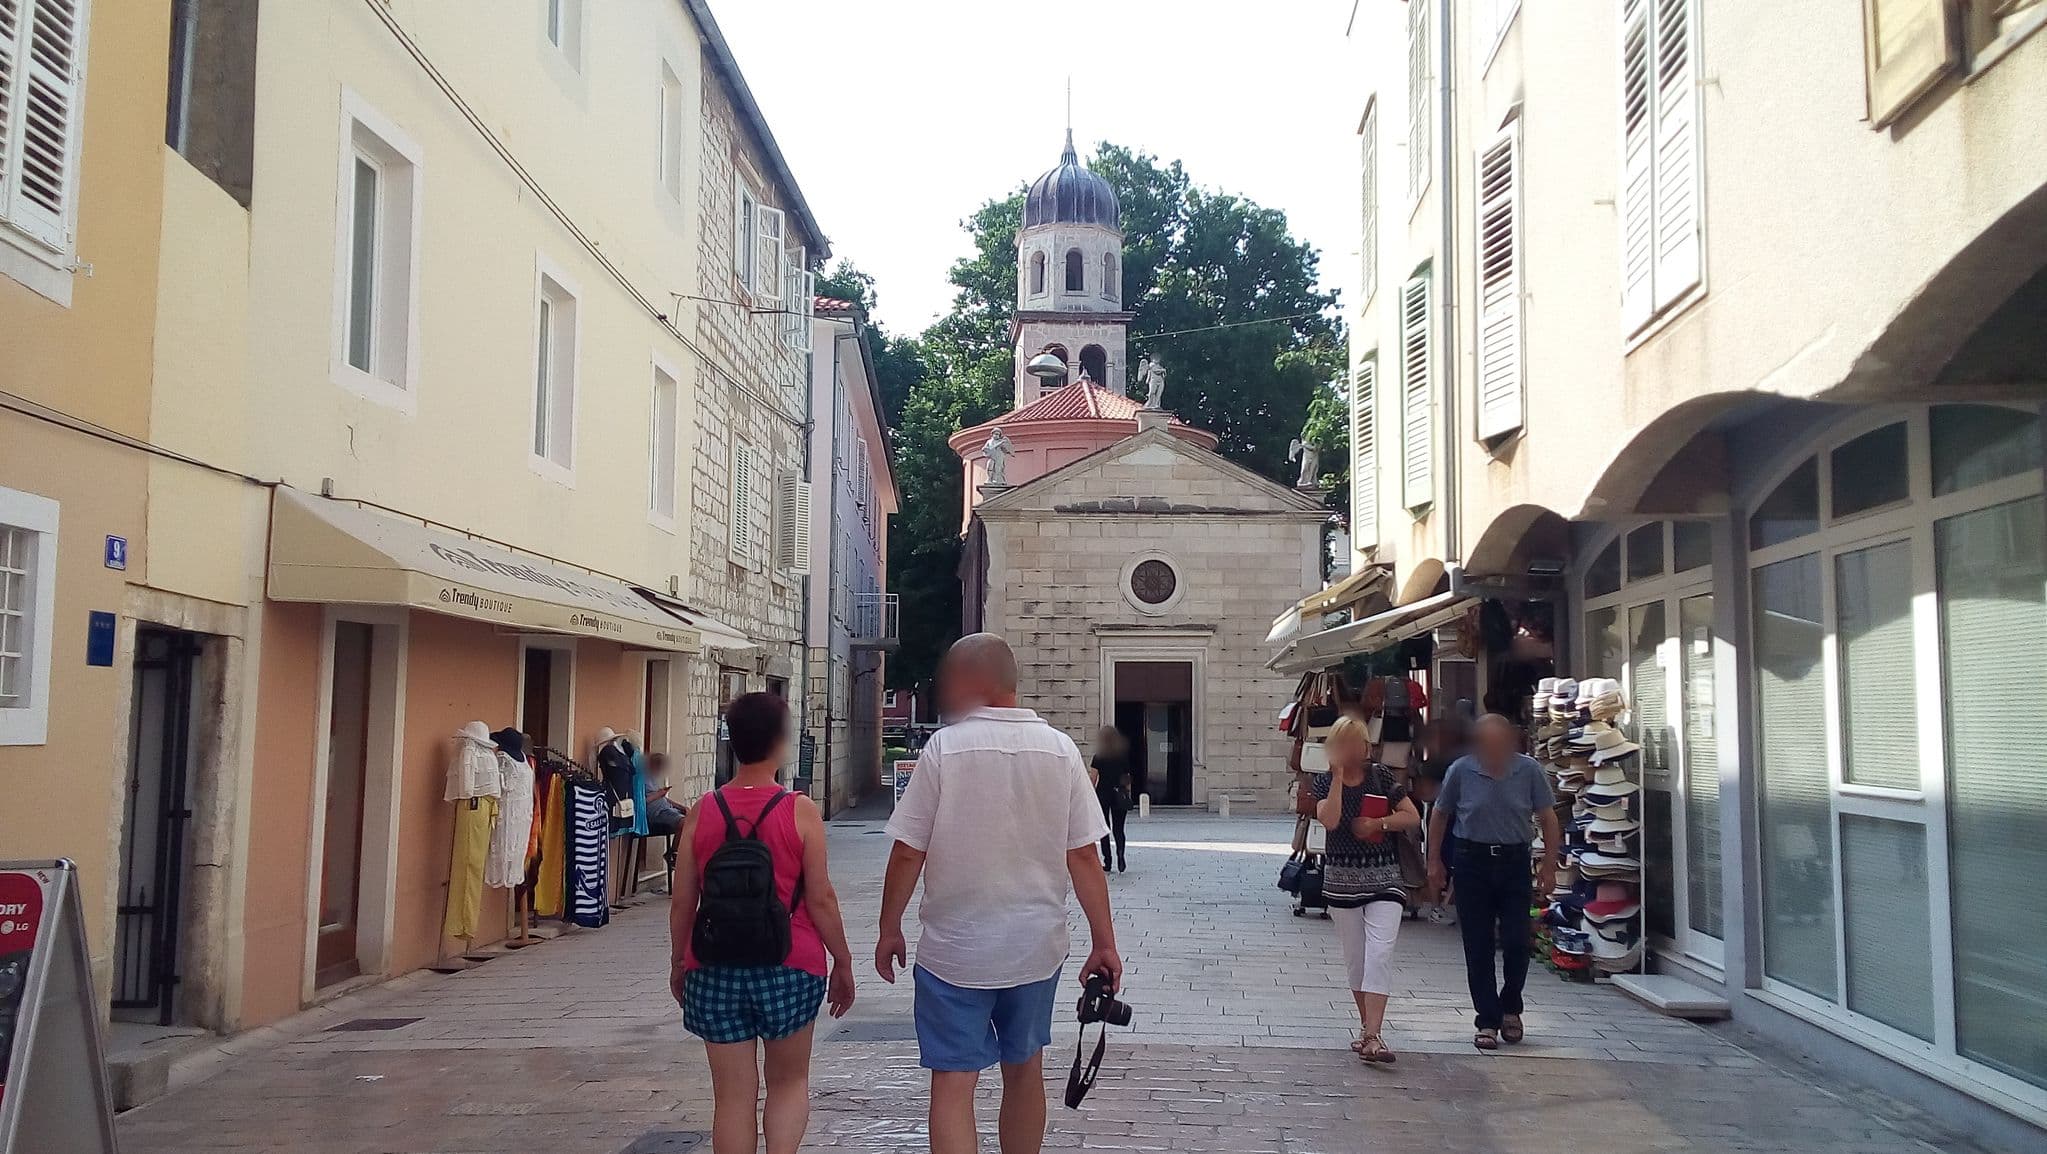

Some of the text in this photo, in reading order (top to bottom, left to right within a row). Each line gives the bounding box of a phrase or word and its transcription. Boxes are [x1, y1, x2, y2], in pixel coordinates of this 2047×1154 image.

[113, 541, 120, 558] 9
[452, 588, 513, 613] Trendy BOUTIQUE
[579, 613, 600, 632] Trendy
[16, 923, 29, 931] LG
